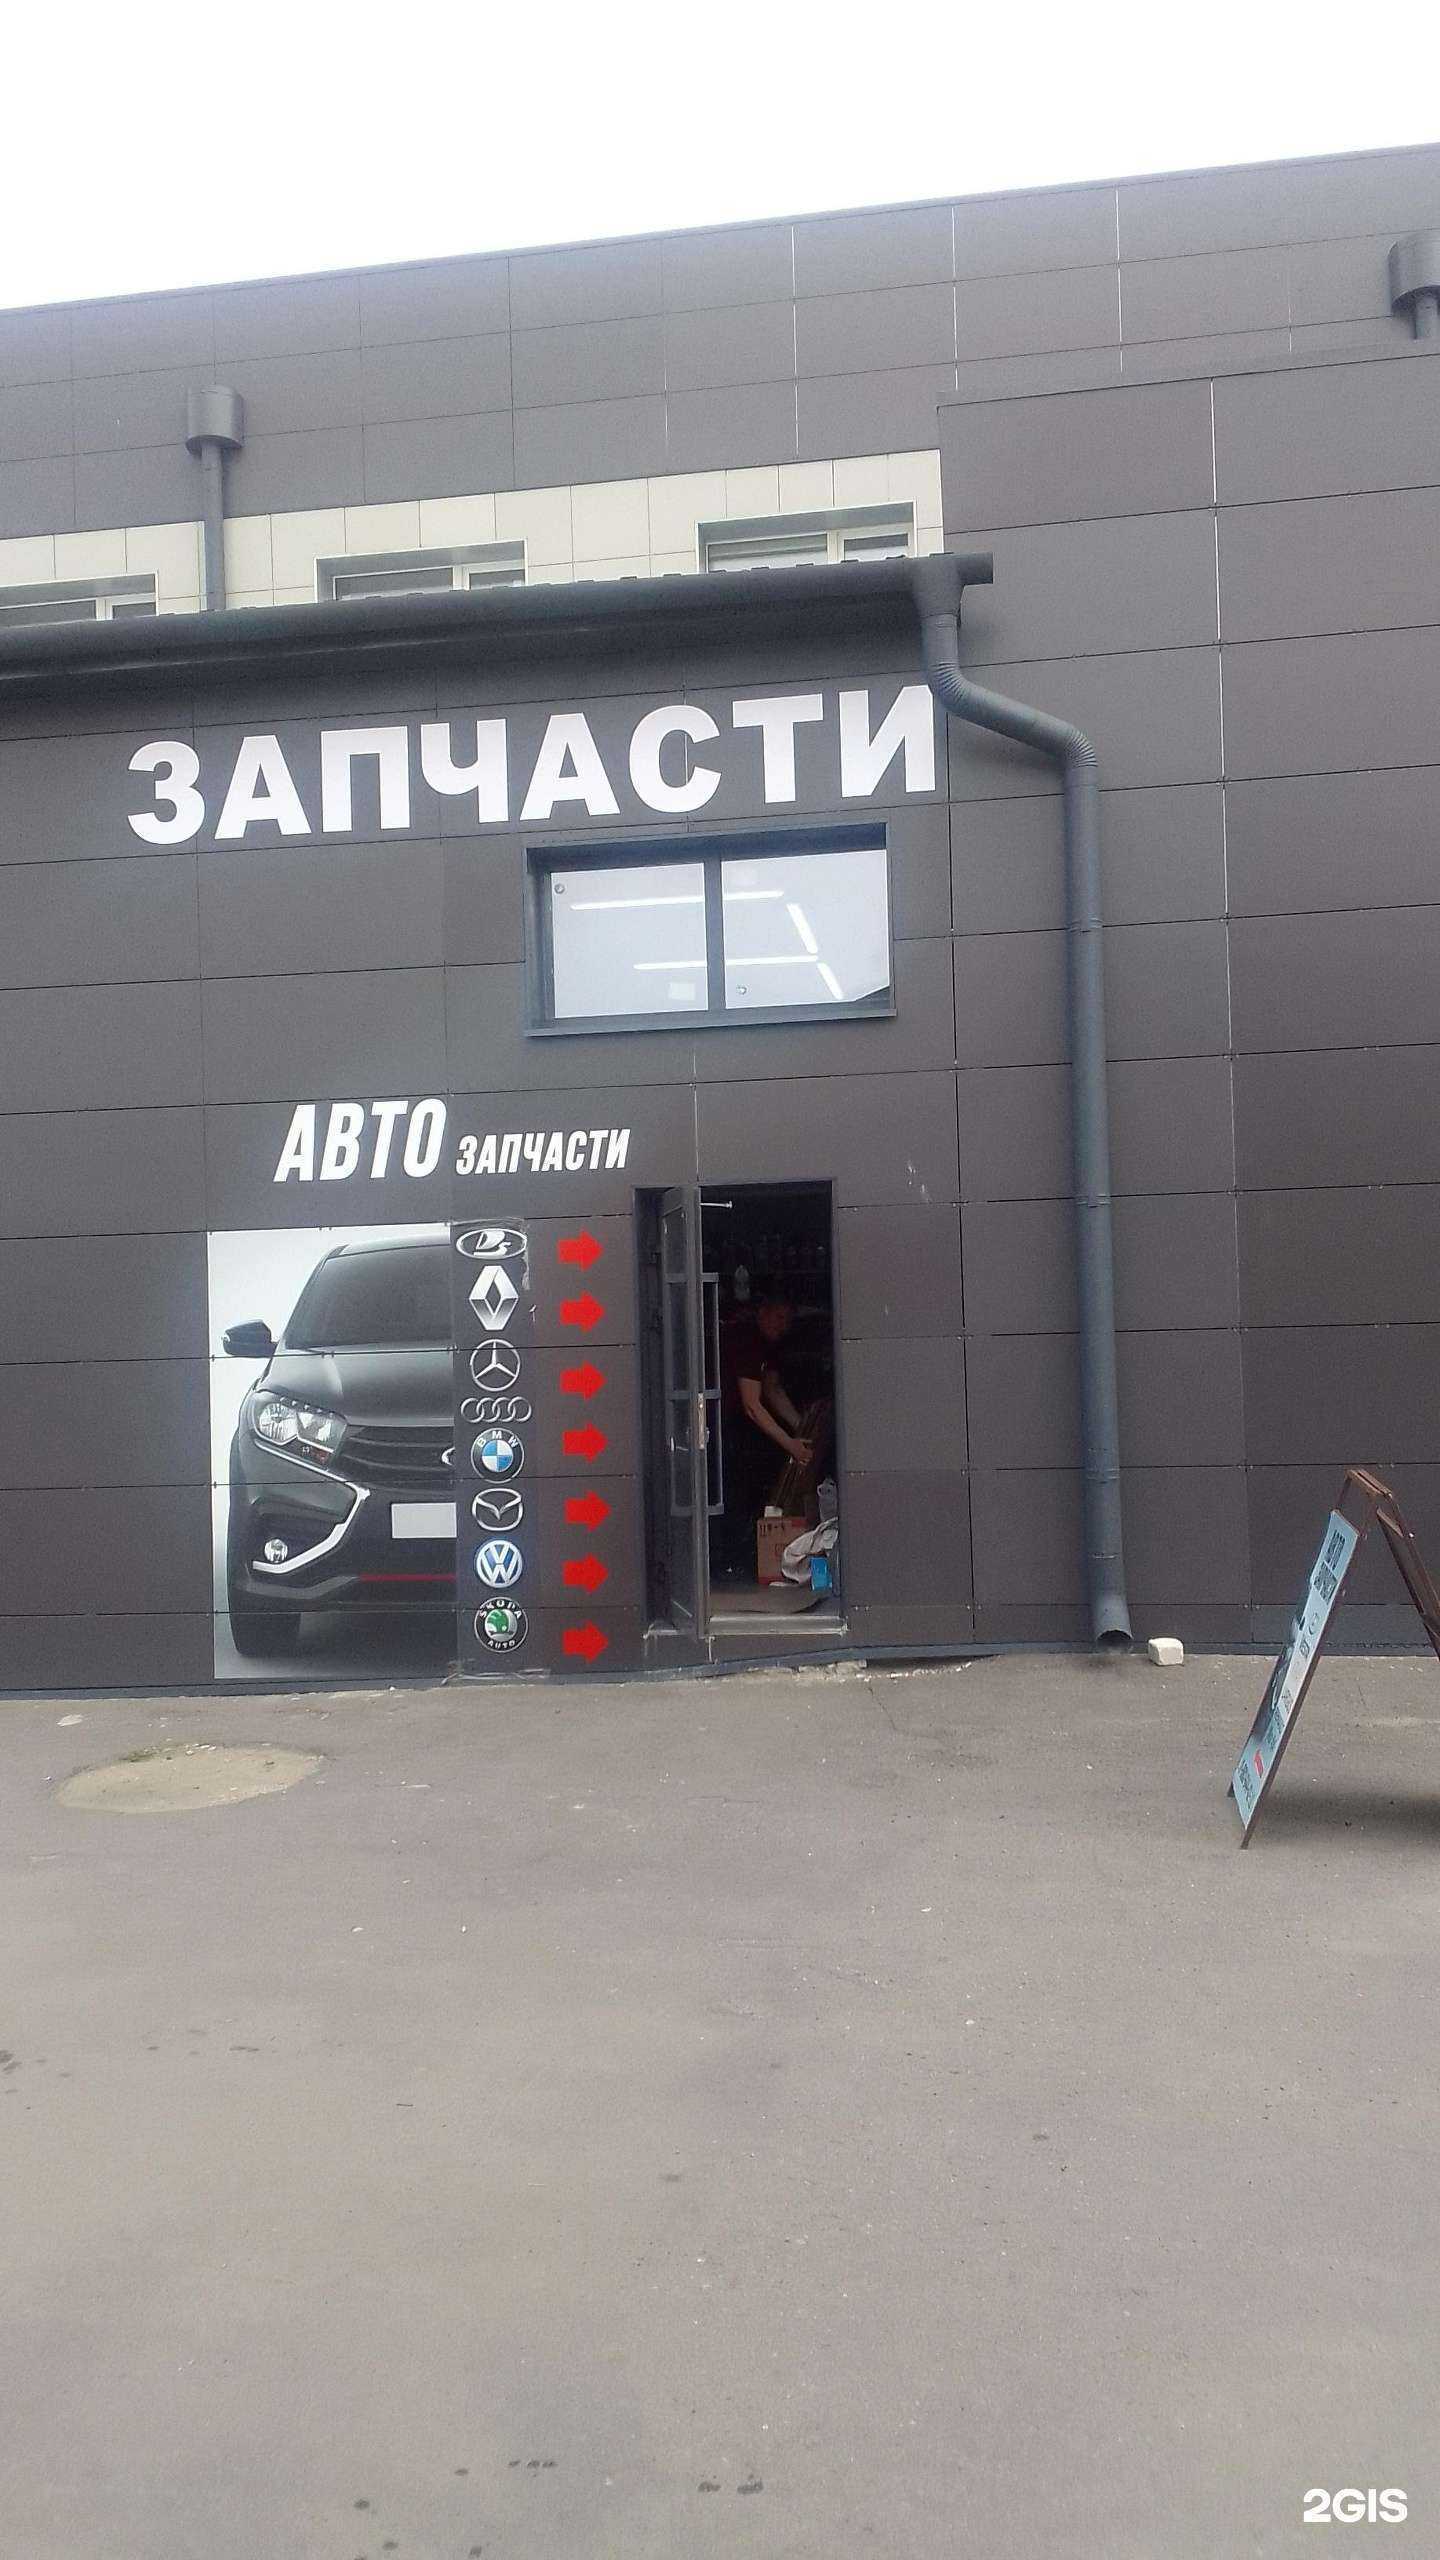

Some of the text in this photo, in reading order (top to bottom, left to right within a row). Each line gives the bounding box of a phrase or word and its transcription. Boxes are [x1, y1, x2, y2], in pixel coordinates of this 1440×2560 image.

[127, 684, 936, 845] ЗАПЧАСТИ
[273, 1098, 631, 1182] АВТО ЗАПЧАСТИ
[476, 1430, 519, 1448] BMW
[487, 1639, 516, 1649] AUTO
